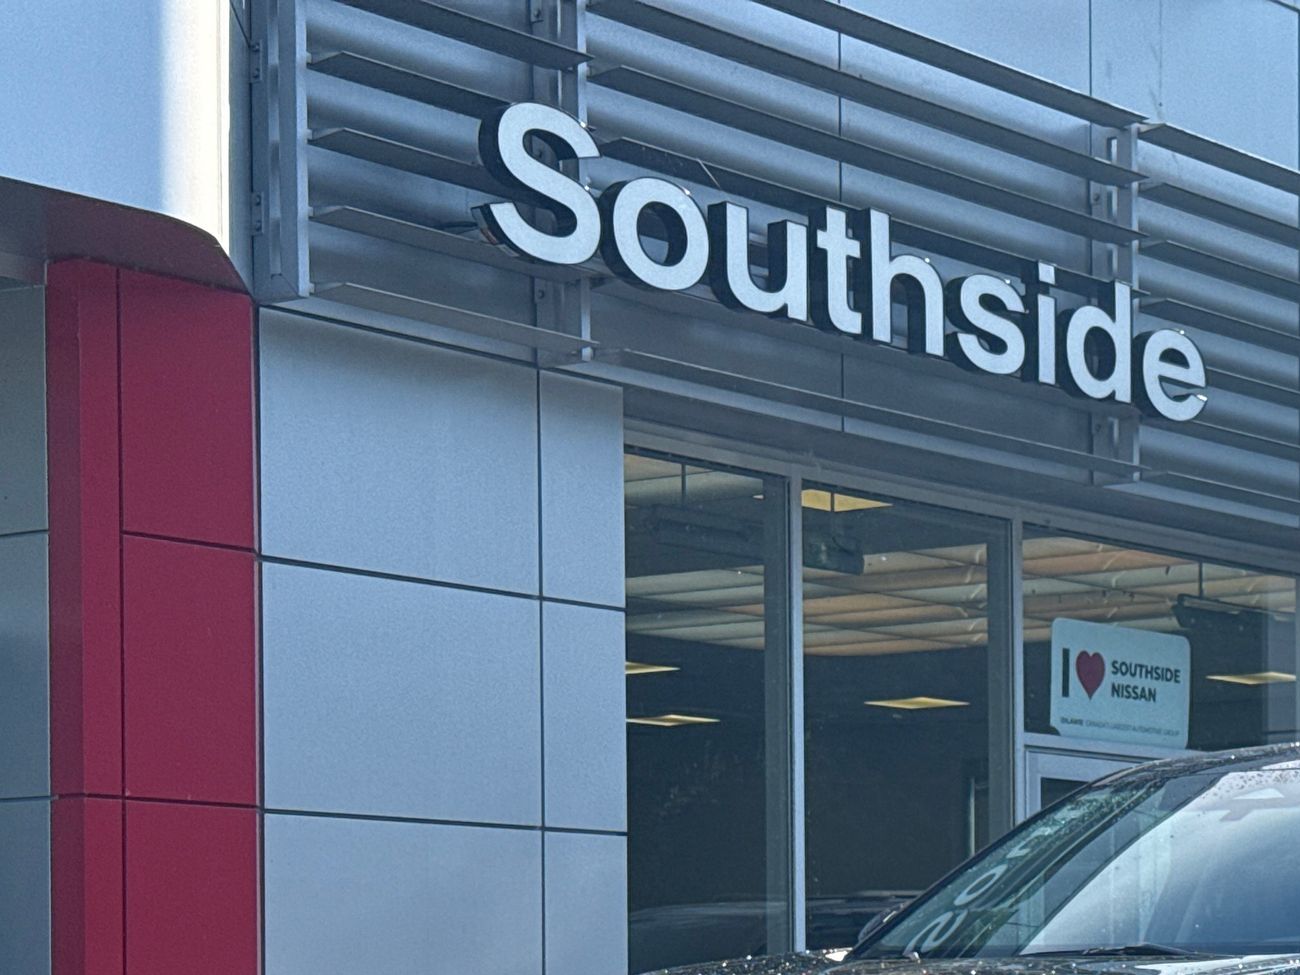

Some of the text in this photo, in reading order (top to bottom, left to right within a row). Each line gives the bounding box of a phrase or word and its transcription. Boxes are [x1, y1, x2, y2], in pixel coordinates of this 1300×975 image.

[486, 102, 1208, 422] Southside
[1061, 647, 1182, 698] I SOUTHSIDE
[1111, 682, 1157, 703] NISSAN
